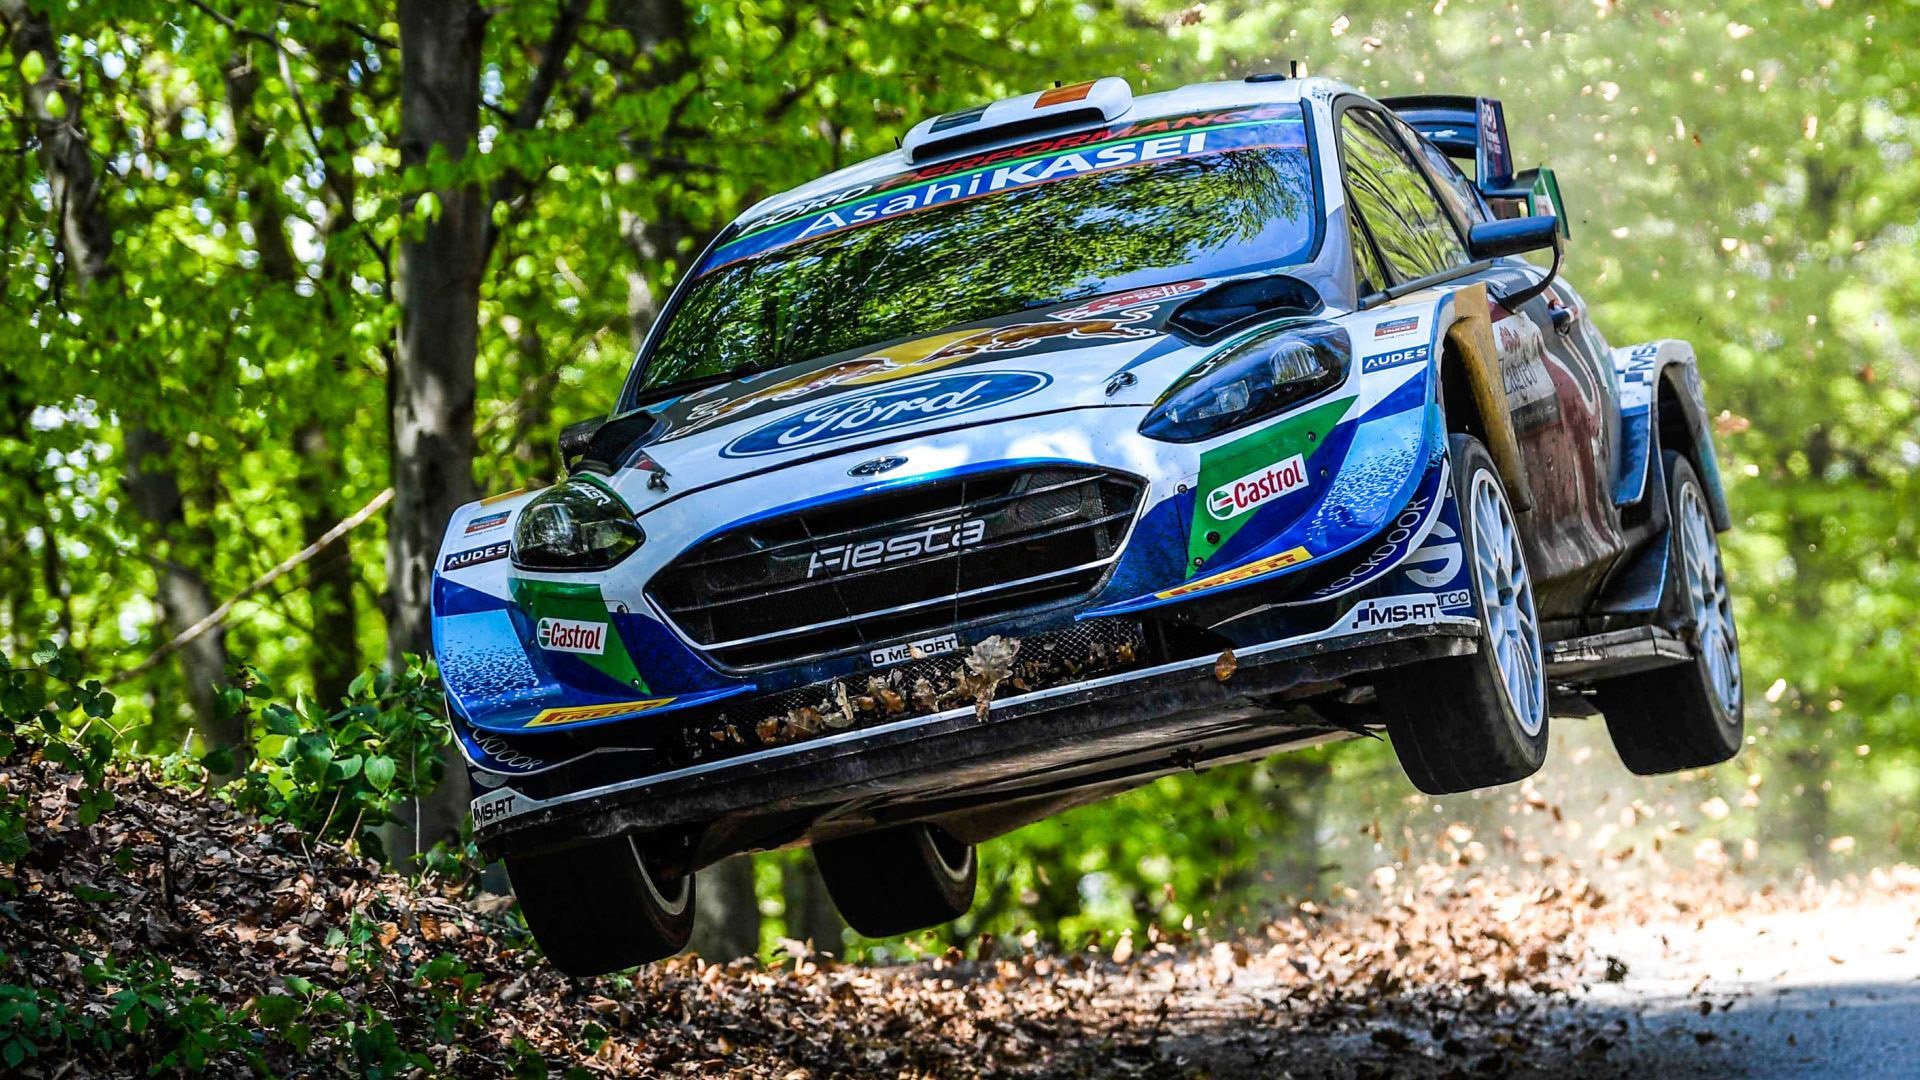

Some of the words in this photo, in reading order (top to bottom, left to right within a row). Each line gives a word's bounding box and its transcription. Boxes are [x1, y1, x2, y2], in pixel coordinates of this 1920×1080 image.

[1364, 347, 1428, 370] AUDES
[777, 376, 989, 445] Ford
[860, 459, 896, 473] Ford
[1233, 459, 1304, 510] Castrol
[446, 544, 507, 566] AUDES
[806, 519, 986, 579] Fiesta
[1313, 495, 1430, 596] ROCKDOOR
[550, 621, 601, 650] Castrol
